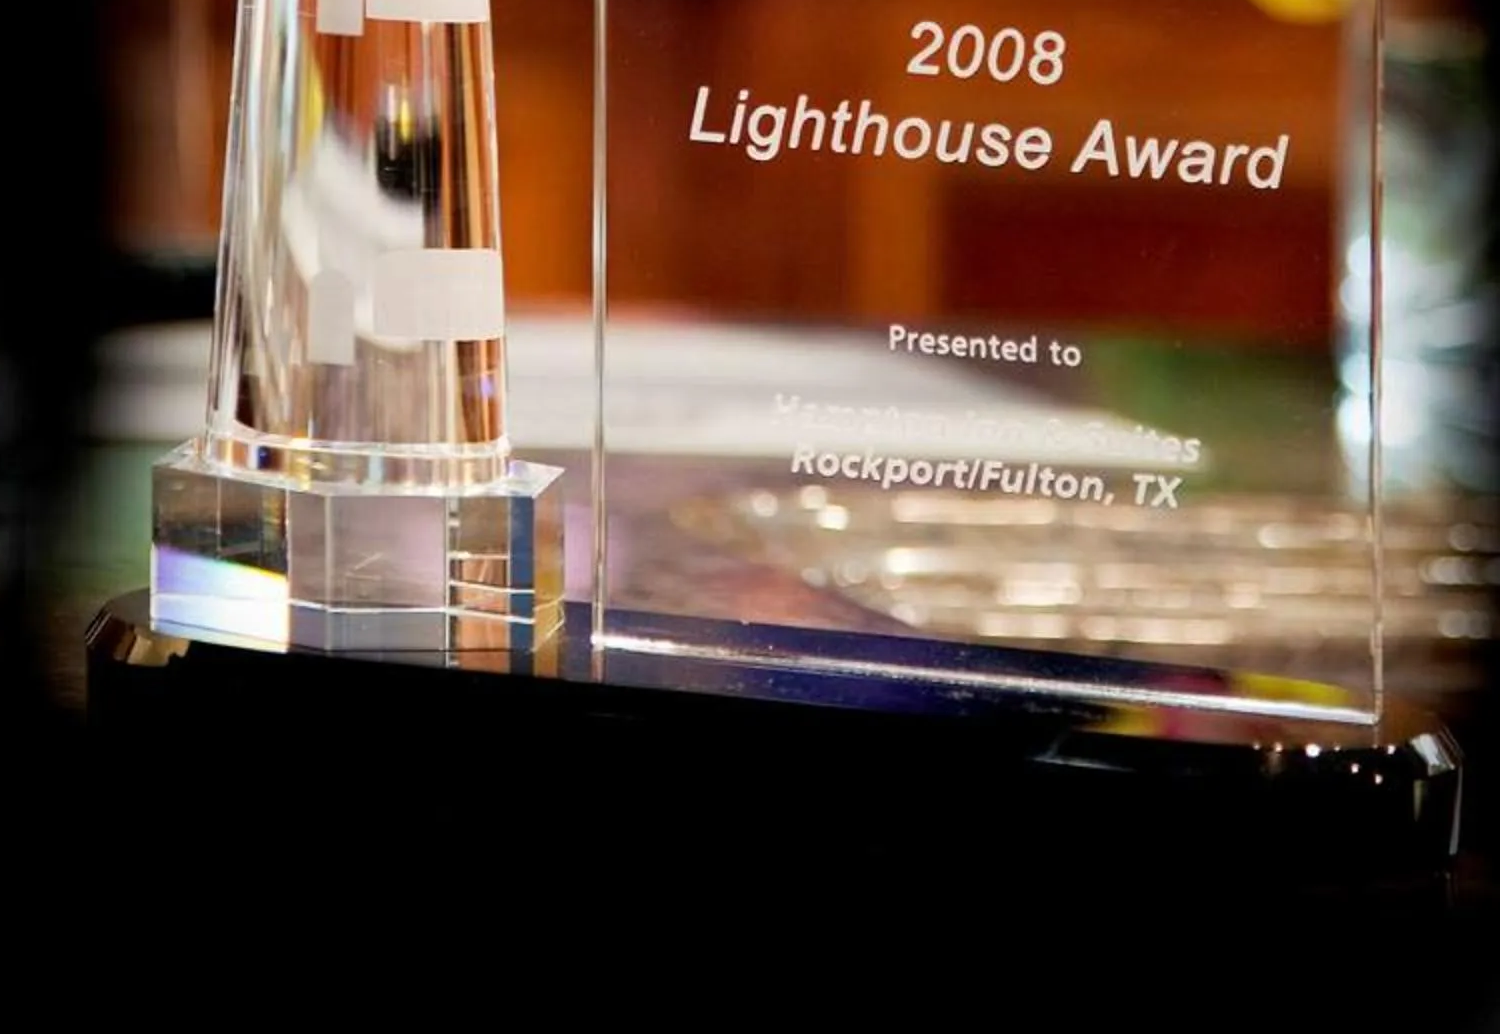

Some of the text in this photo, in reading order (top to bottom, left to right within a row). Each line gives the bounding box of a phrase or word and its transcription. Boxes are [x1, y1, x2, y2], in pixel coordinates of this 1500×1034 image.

[906, 21, 1067, 85] 2008
[689, 86, 1290, 190] Lighthouse Award
[888, 325, 1083, 367] Presented to
[791, 443, 1183, 509] Rockport/Fulton, TX
